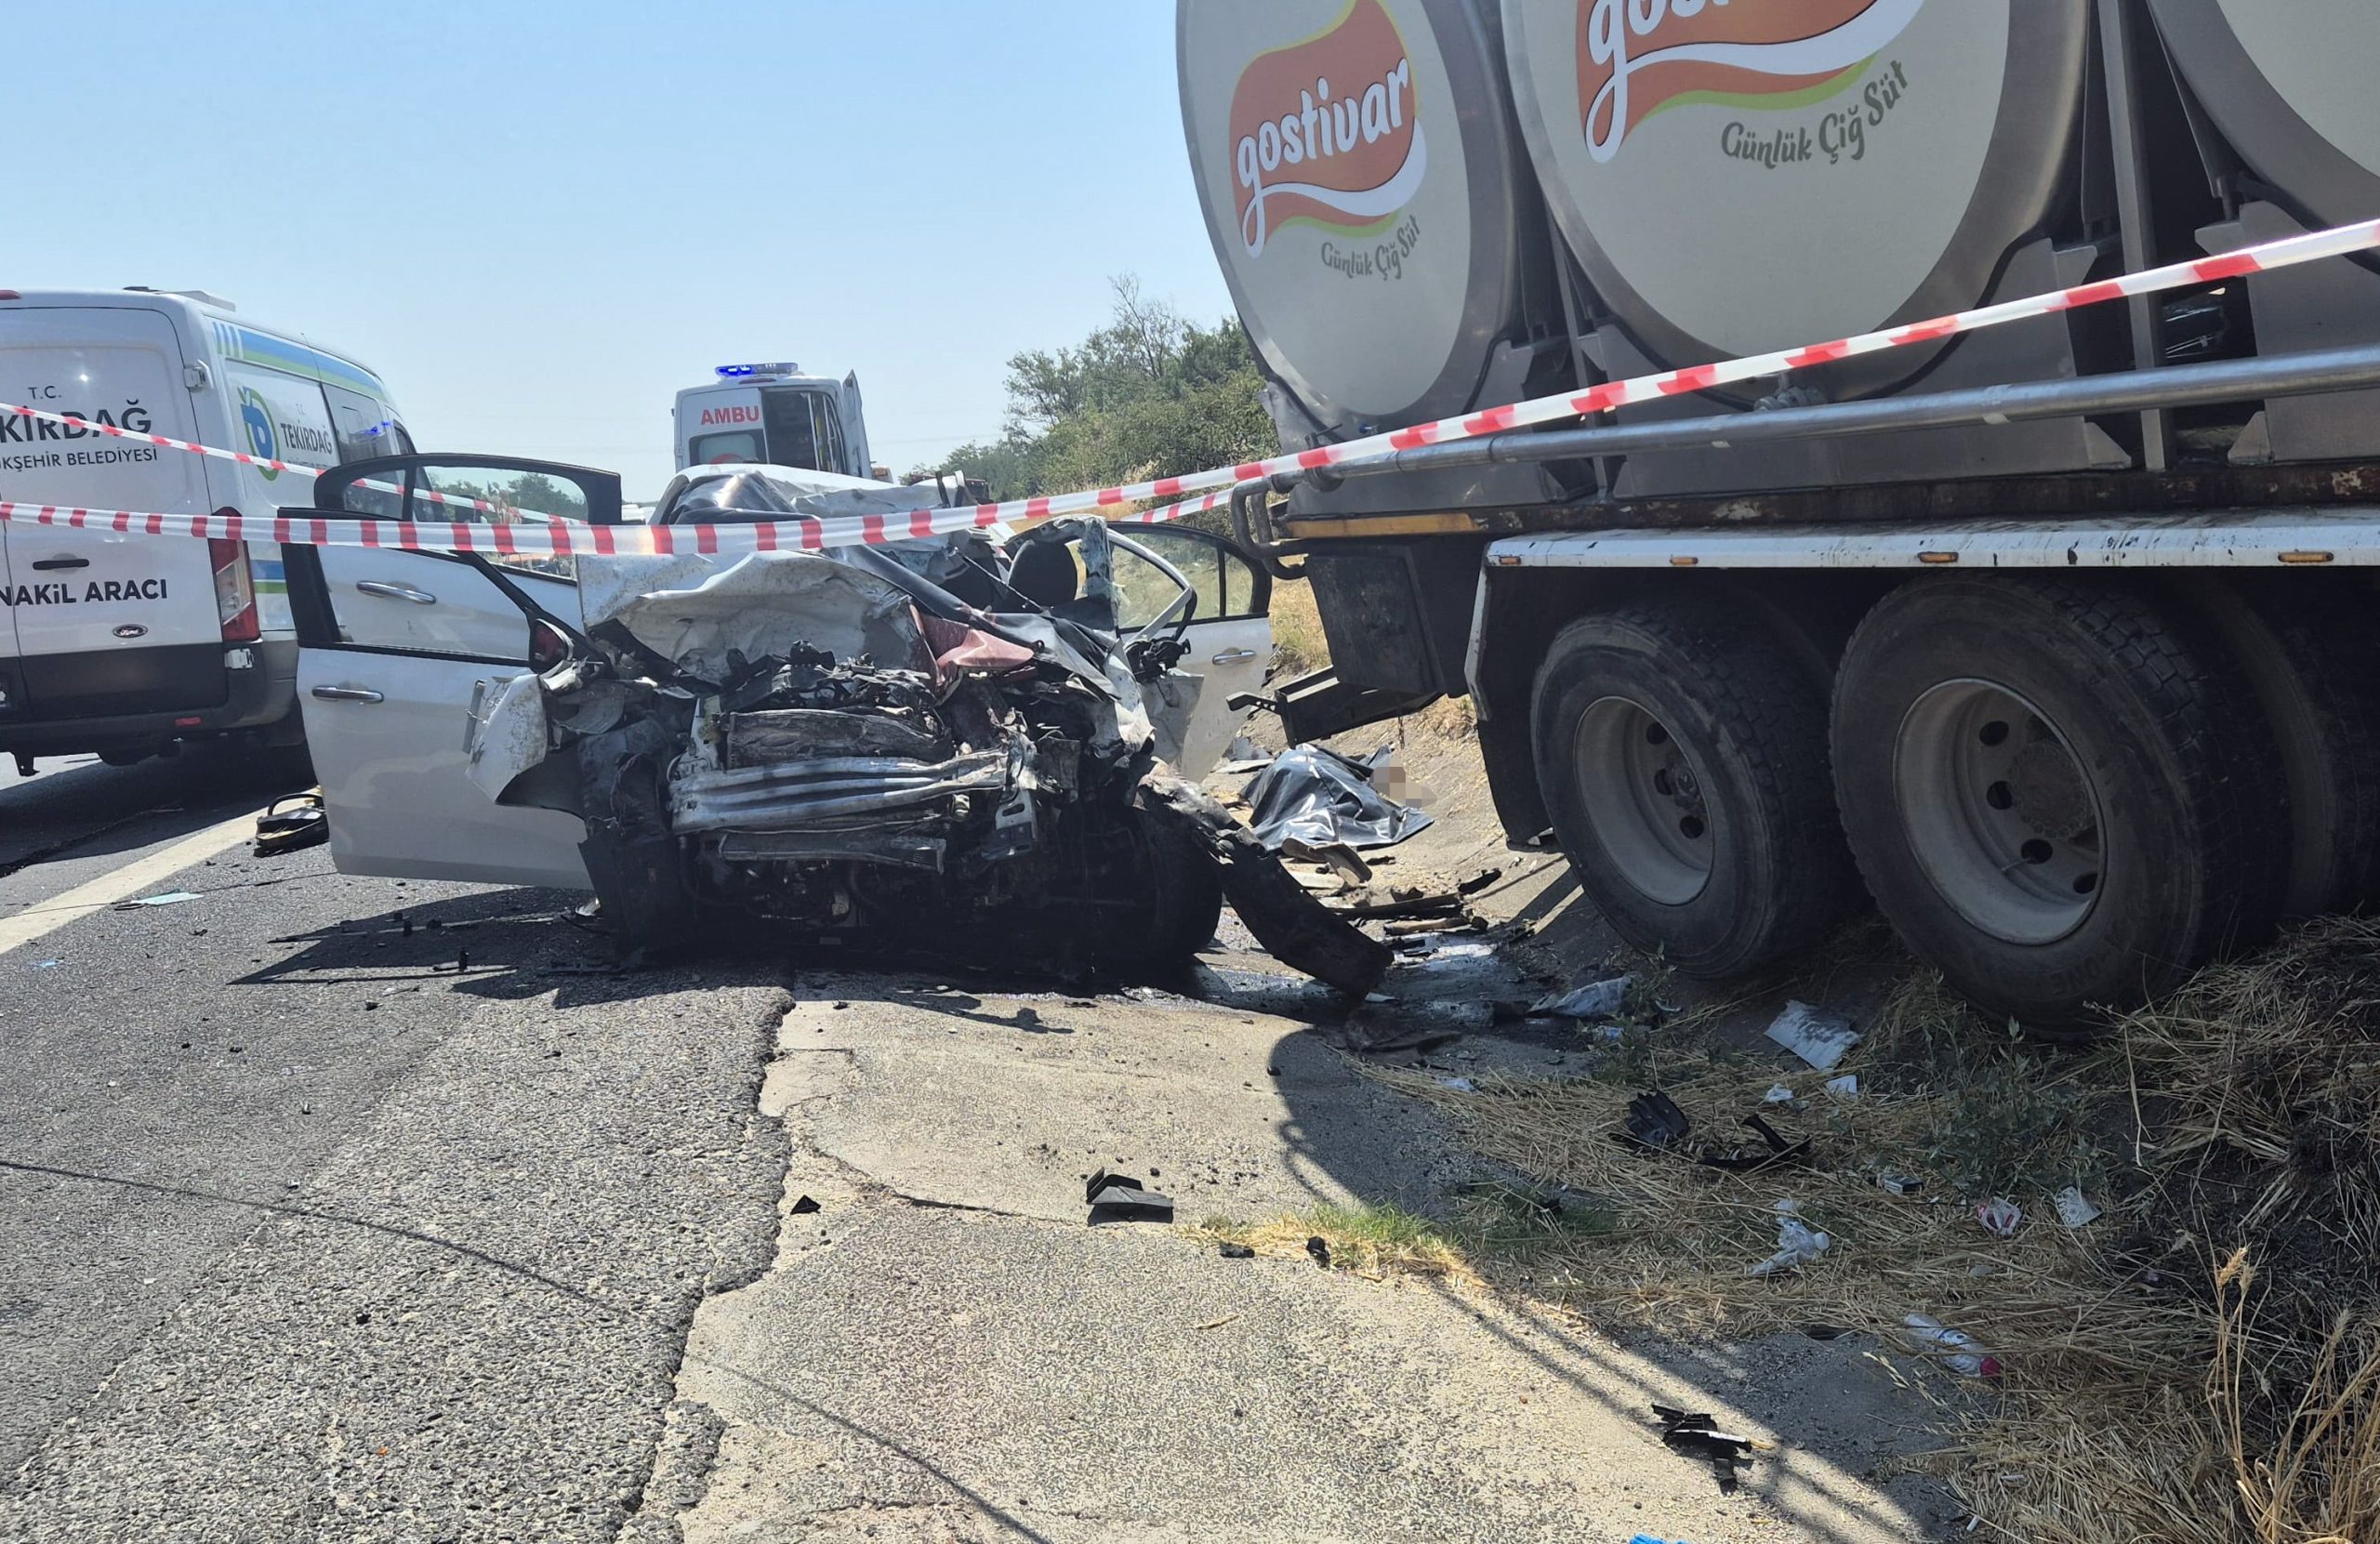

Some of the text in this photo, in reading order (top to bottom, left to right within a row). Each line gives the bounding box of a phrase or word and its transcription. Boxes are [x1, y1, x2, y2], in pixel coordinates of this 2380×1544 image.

[1721, 59, 1908, 169] Günlük Çiğ Süt
[1237, 58, 1409, 259] gostivar
[1321, 214, 1420, 281] Günlük Çiğ Süt
[28, 385, 62, 400] T.C.
[700, 405, 760, 425] AMBU
[0, 445, 158, 472] KŞEHİR BELEDİYESİ
[85, 578, 166, 602] ARACI
